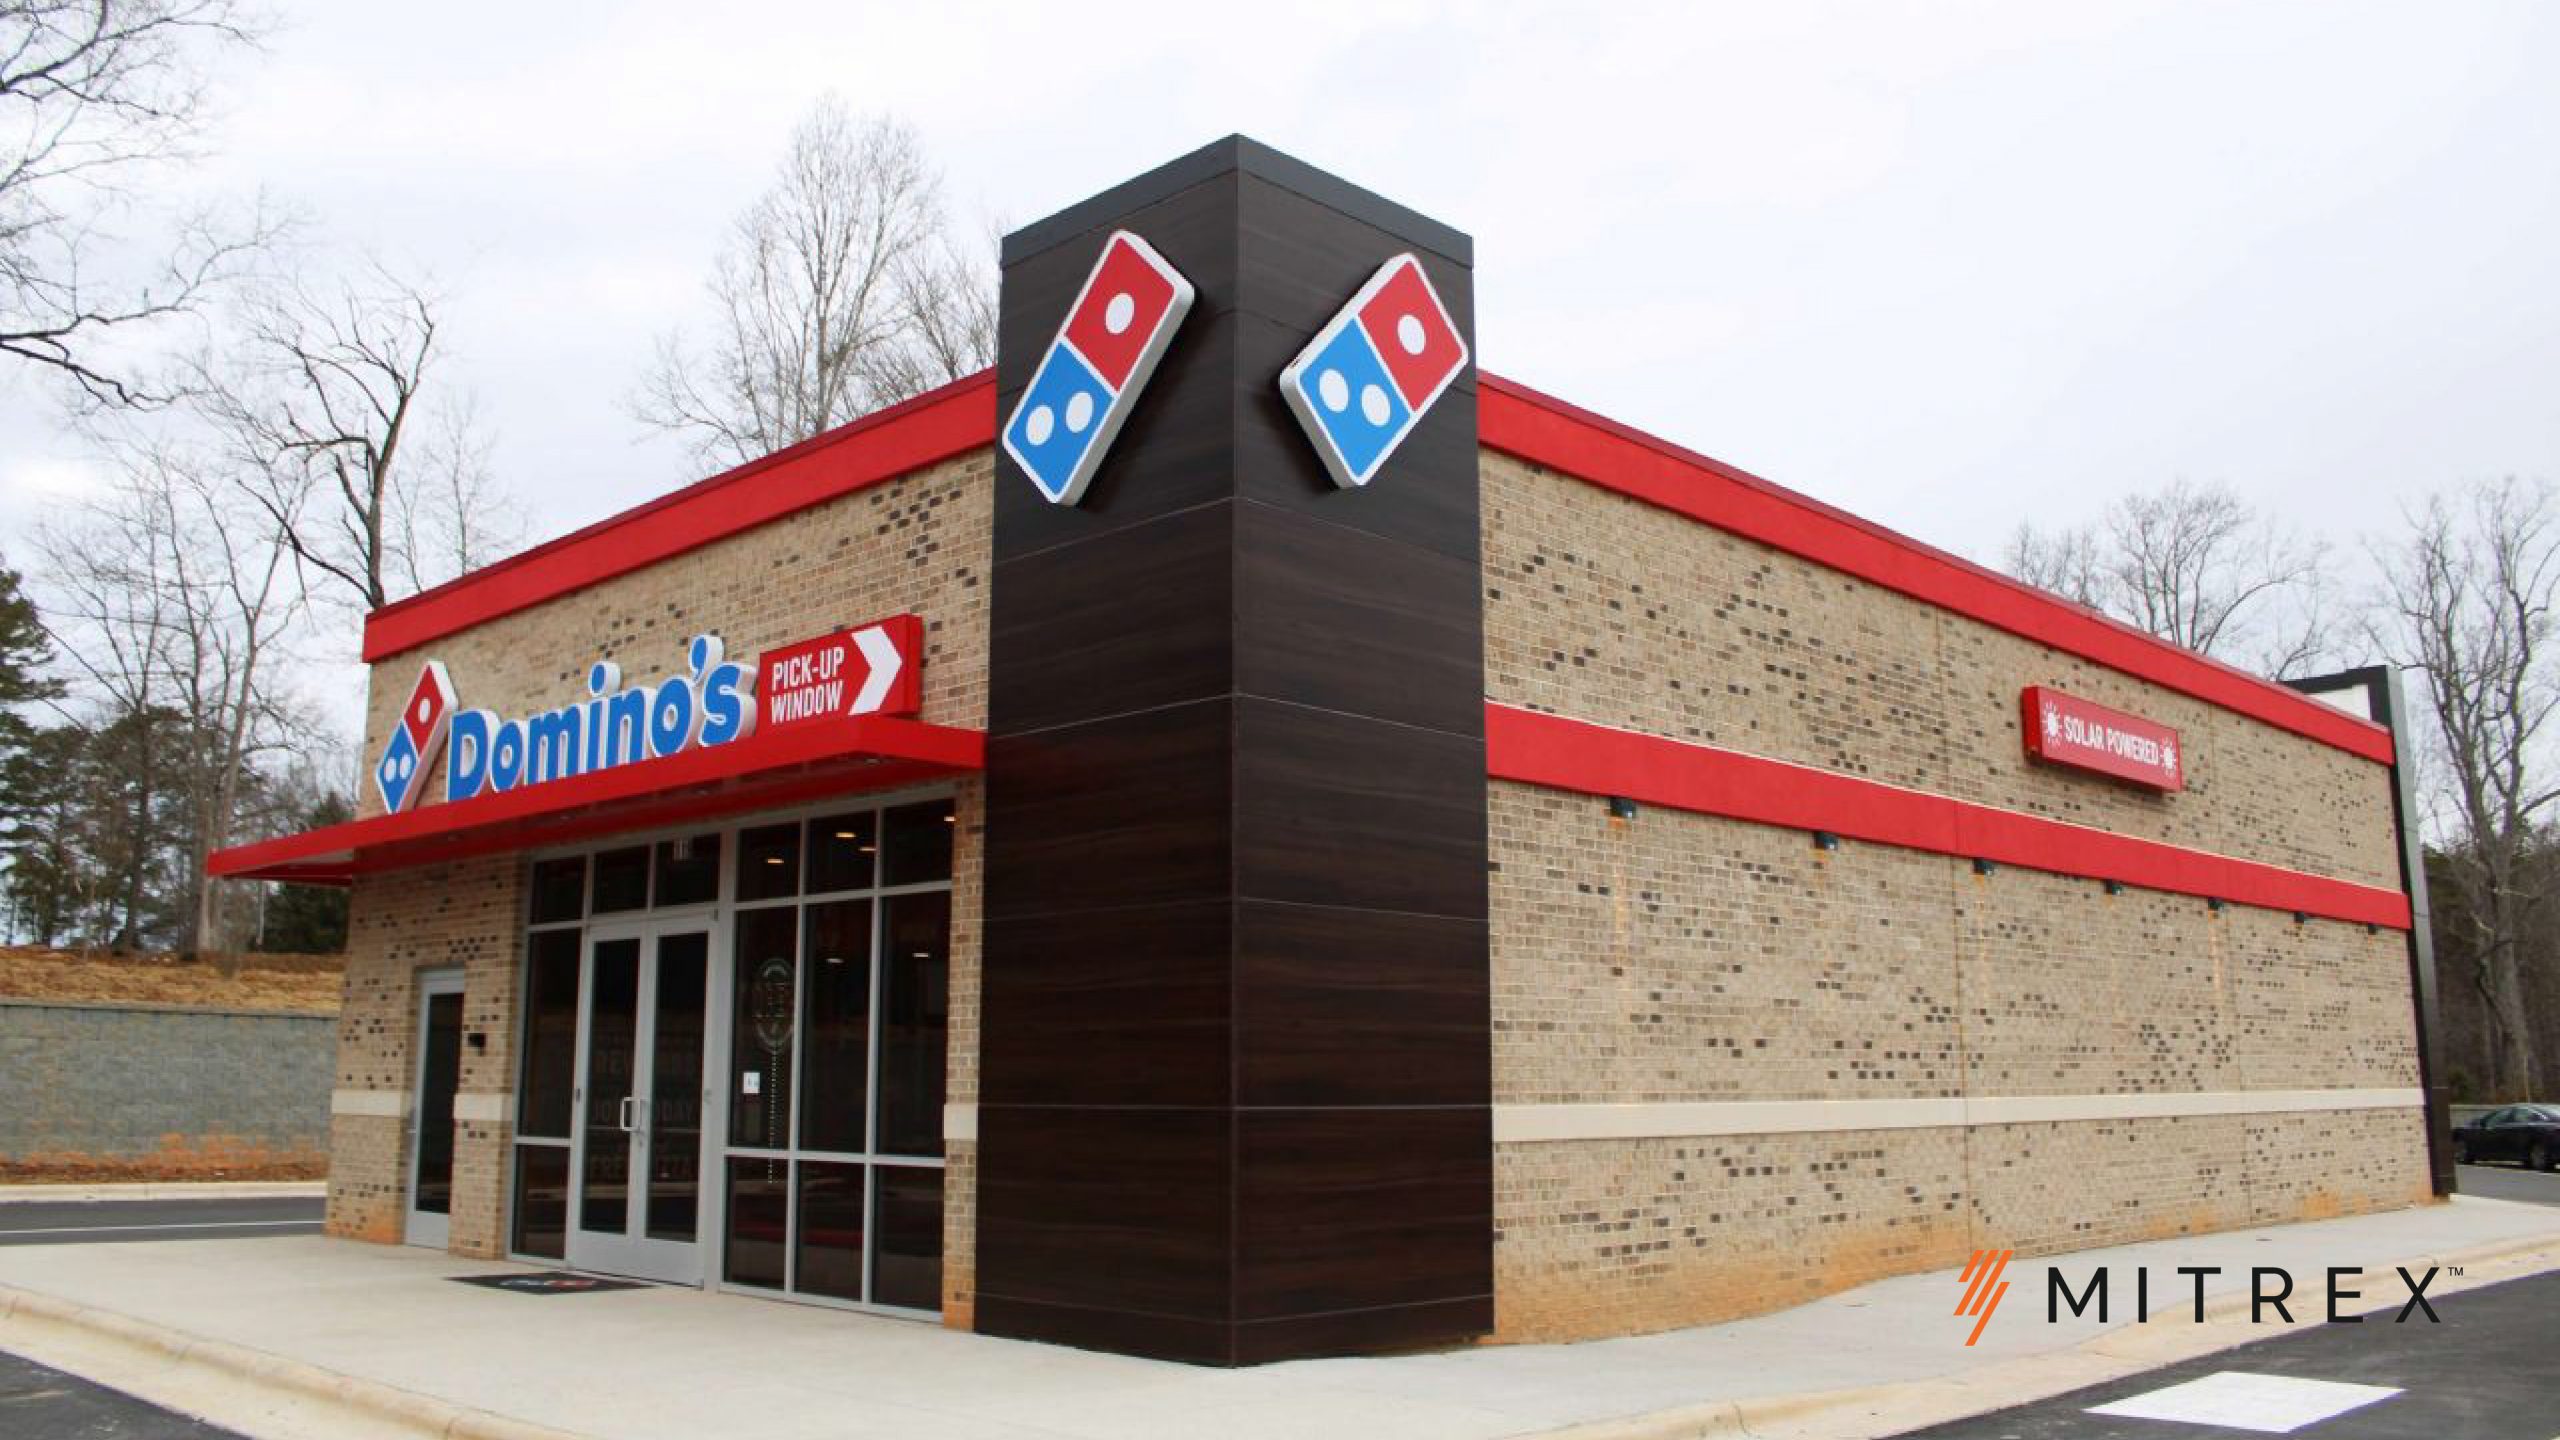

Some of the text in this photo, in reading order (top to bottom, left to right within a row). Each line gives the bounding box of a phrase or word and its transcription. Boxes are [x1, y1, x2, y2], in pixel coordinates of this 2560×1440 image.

[772, 646, 845, 692] PICK-UP
[447, 635, 757, 803] Domino's
[771, 679, 845, 726] WINDOW
[2063, 715, 2159, 765] SOLAR POWERED
